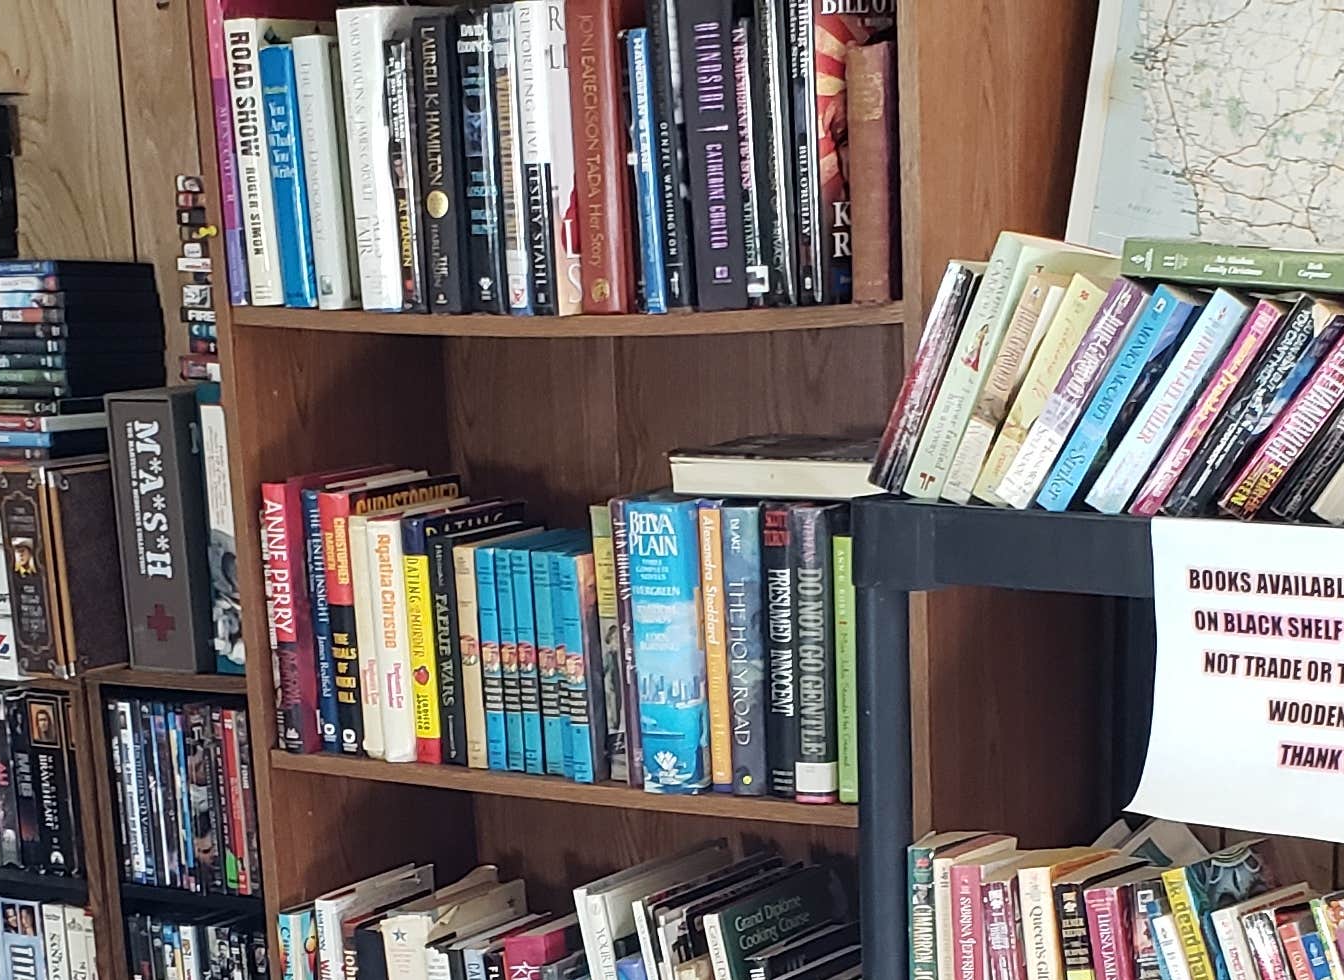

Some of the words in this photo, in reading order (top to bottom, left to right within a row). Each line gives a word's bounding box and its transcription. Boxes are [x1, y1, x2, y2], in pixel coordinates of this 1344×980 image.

[229, 31, 255, 90] ROAD
[421, 26, 438, 96] LAURELL
[694, 22, 725, 113] BLINDSIDE
[236, 96, 260, 156] SHOW
[425, 111, 443, 186] HAMILTON
[245, 167, 259, 211] ROGER
[705, 143, 727, 199] CATHERINE
[251, 214, 264, 256] SIMON
[663, 175, 678, 256] WASHINGTON
[709, 202, 728, 250] COULTER
[532, 228, 546, 285] STAHL
[1266, 377, 1341, 467] EVANOVICH
[263, 499, 289, 563] ANNE
[333, 518, 349, 585] CHRISTOPHER
[629, 534, 678, 556] PLAIN
[630, 512, 674, 535] BELVA
[702, 515, 719, 582] Alexandra
[377, 534, 394, 588] Agatha
[798, 568, 822, 599] DO
[1189, 570, 1251, 593] BOOKS
[272, 567, 294, 635] PERRY
[435, 593, 451, 650] FAERIE
[706, 583, 720, 645] Stoddard
[728, 578, 746, 624] THE
[768, 568, 792, 643] PRESUMED
[798, 602, 824, 642] NOT
[1195, 611, 1218, 631] ON
[1224, 613, 1283, 636] BLACK
[1288, 618, 1343, 641] SHELF
[440, 654, 455, 706] WARS
[730, 626, 749, 684] HOLY
[770, 649, 794, 717] INNOCENT
[798, 645, 825, 678] GO
[1204, 652, 1239, 675] NOT
[1245, 655, 1301, 679] TRADE
[1307, 661, 1332, 683] OR
[732, 687, 751, 746] ROAD
[798, 682, 826, 756] GENTLE
[1281, 745, 1340, 770] THANK
[912, 904, 935, 965] CIMARRON
[1179, 902, 1200, 949] dead
